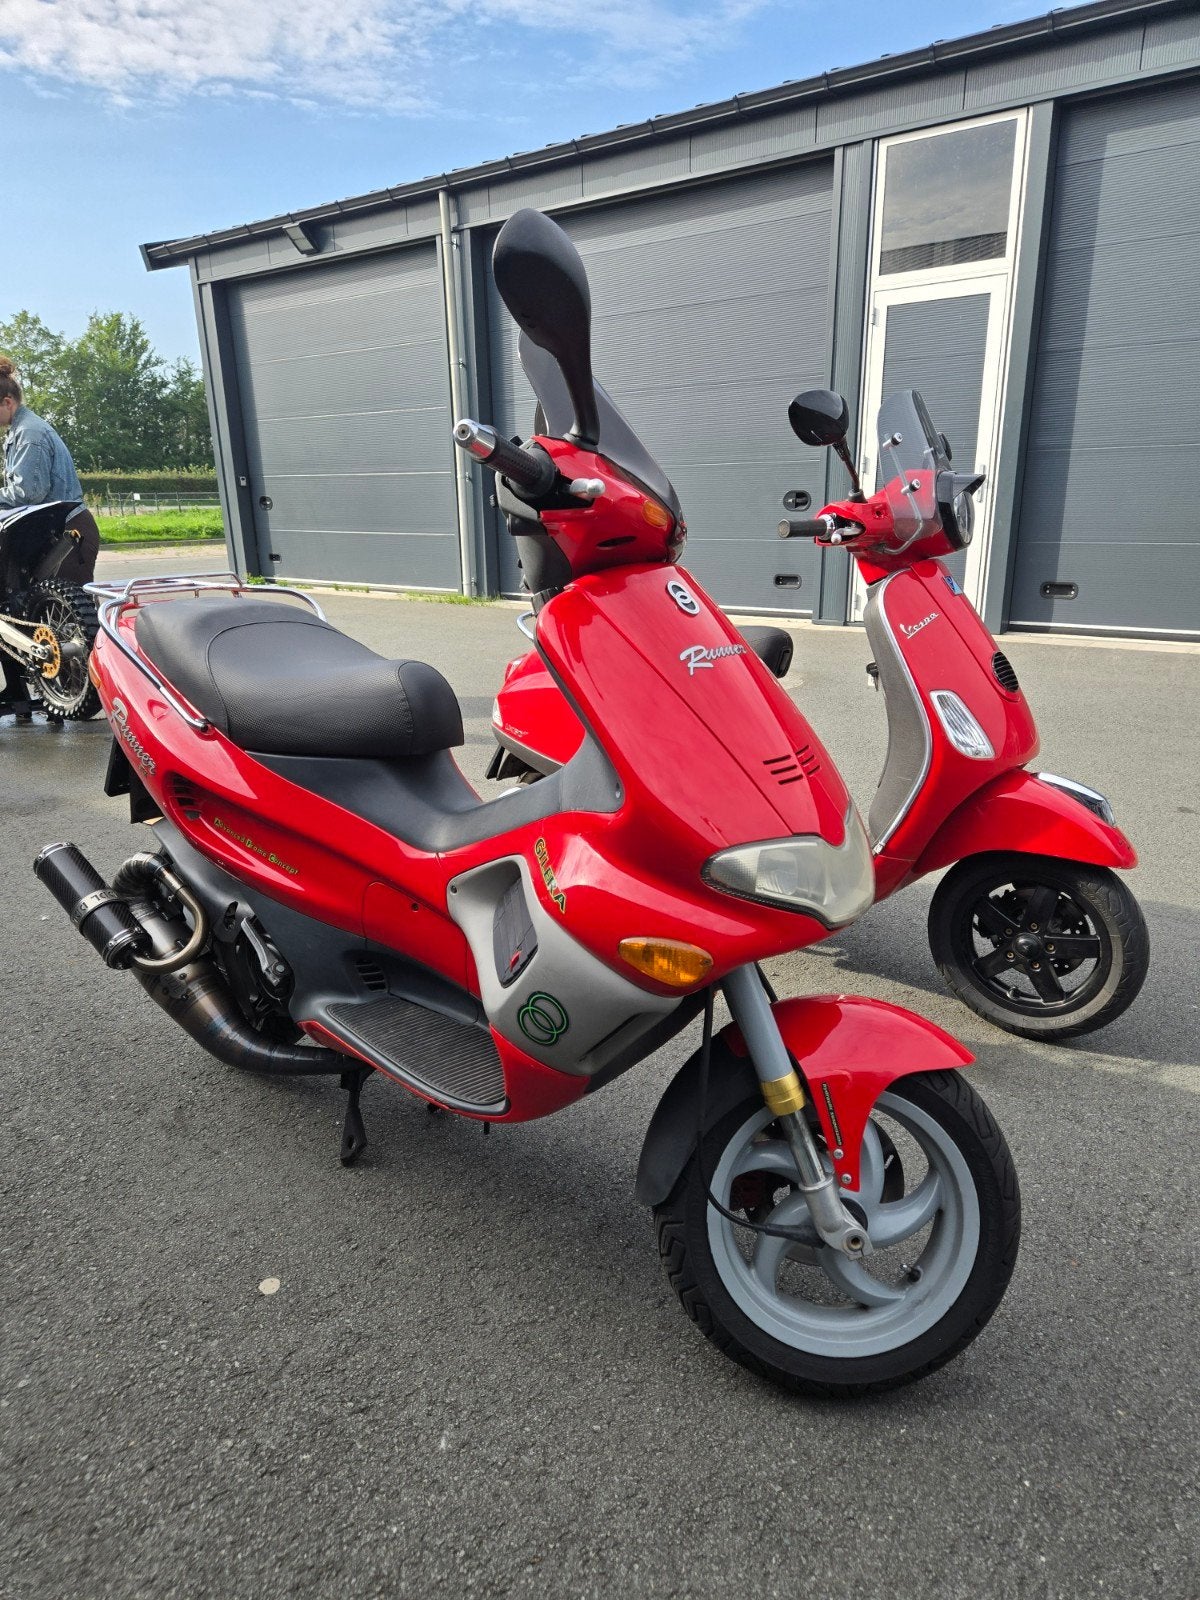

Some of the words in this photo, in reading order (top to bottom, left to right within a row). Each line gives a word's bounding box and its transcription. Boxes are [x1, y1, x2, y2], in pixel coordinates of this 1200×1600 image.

[899, 612, 940, 639] Vespa
[679, 644, 746, 676] Runner
[111, 697, 157, 775] Runner
[214, 818, 246, 843] Advanced
[269, 853, 299, 875] Concept
[535, 837, 566, 915] GILERA
